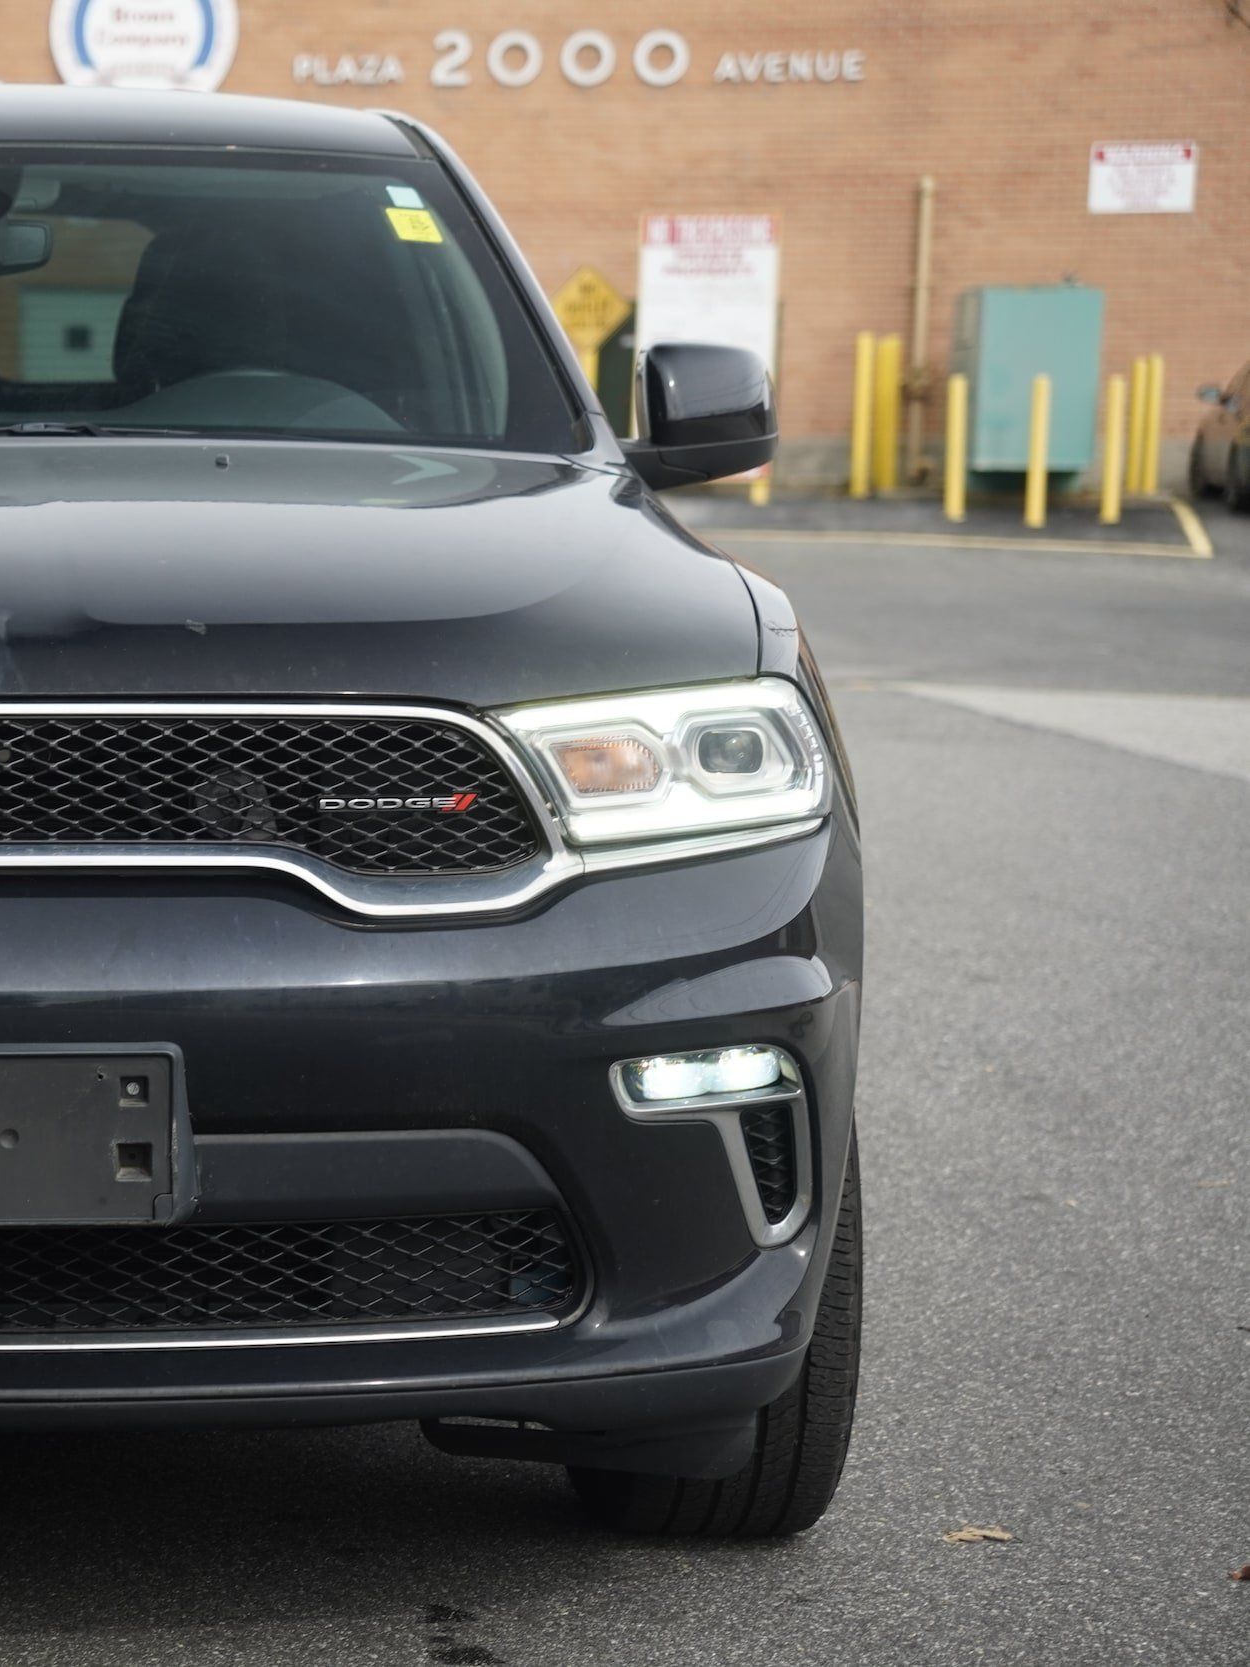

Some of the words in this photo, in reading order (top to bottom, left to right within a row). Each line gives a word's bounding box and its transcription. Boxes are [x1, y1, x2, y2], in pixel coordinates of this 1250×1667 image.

[292, 53, 404, 85] PLAZA
[430, 29, 690, 87] 2000
[713, 49, 866, 83] AVENUE
[319, 797, 457, 810] DODGE
